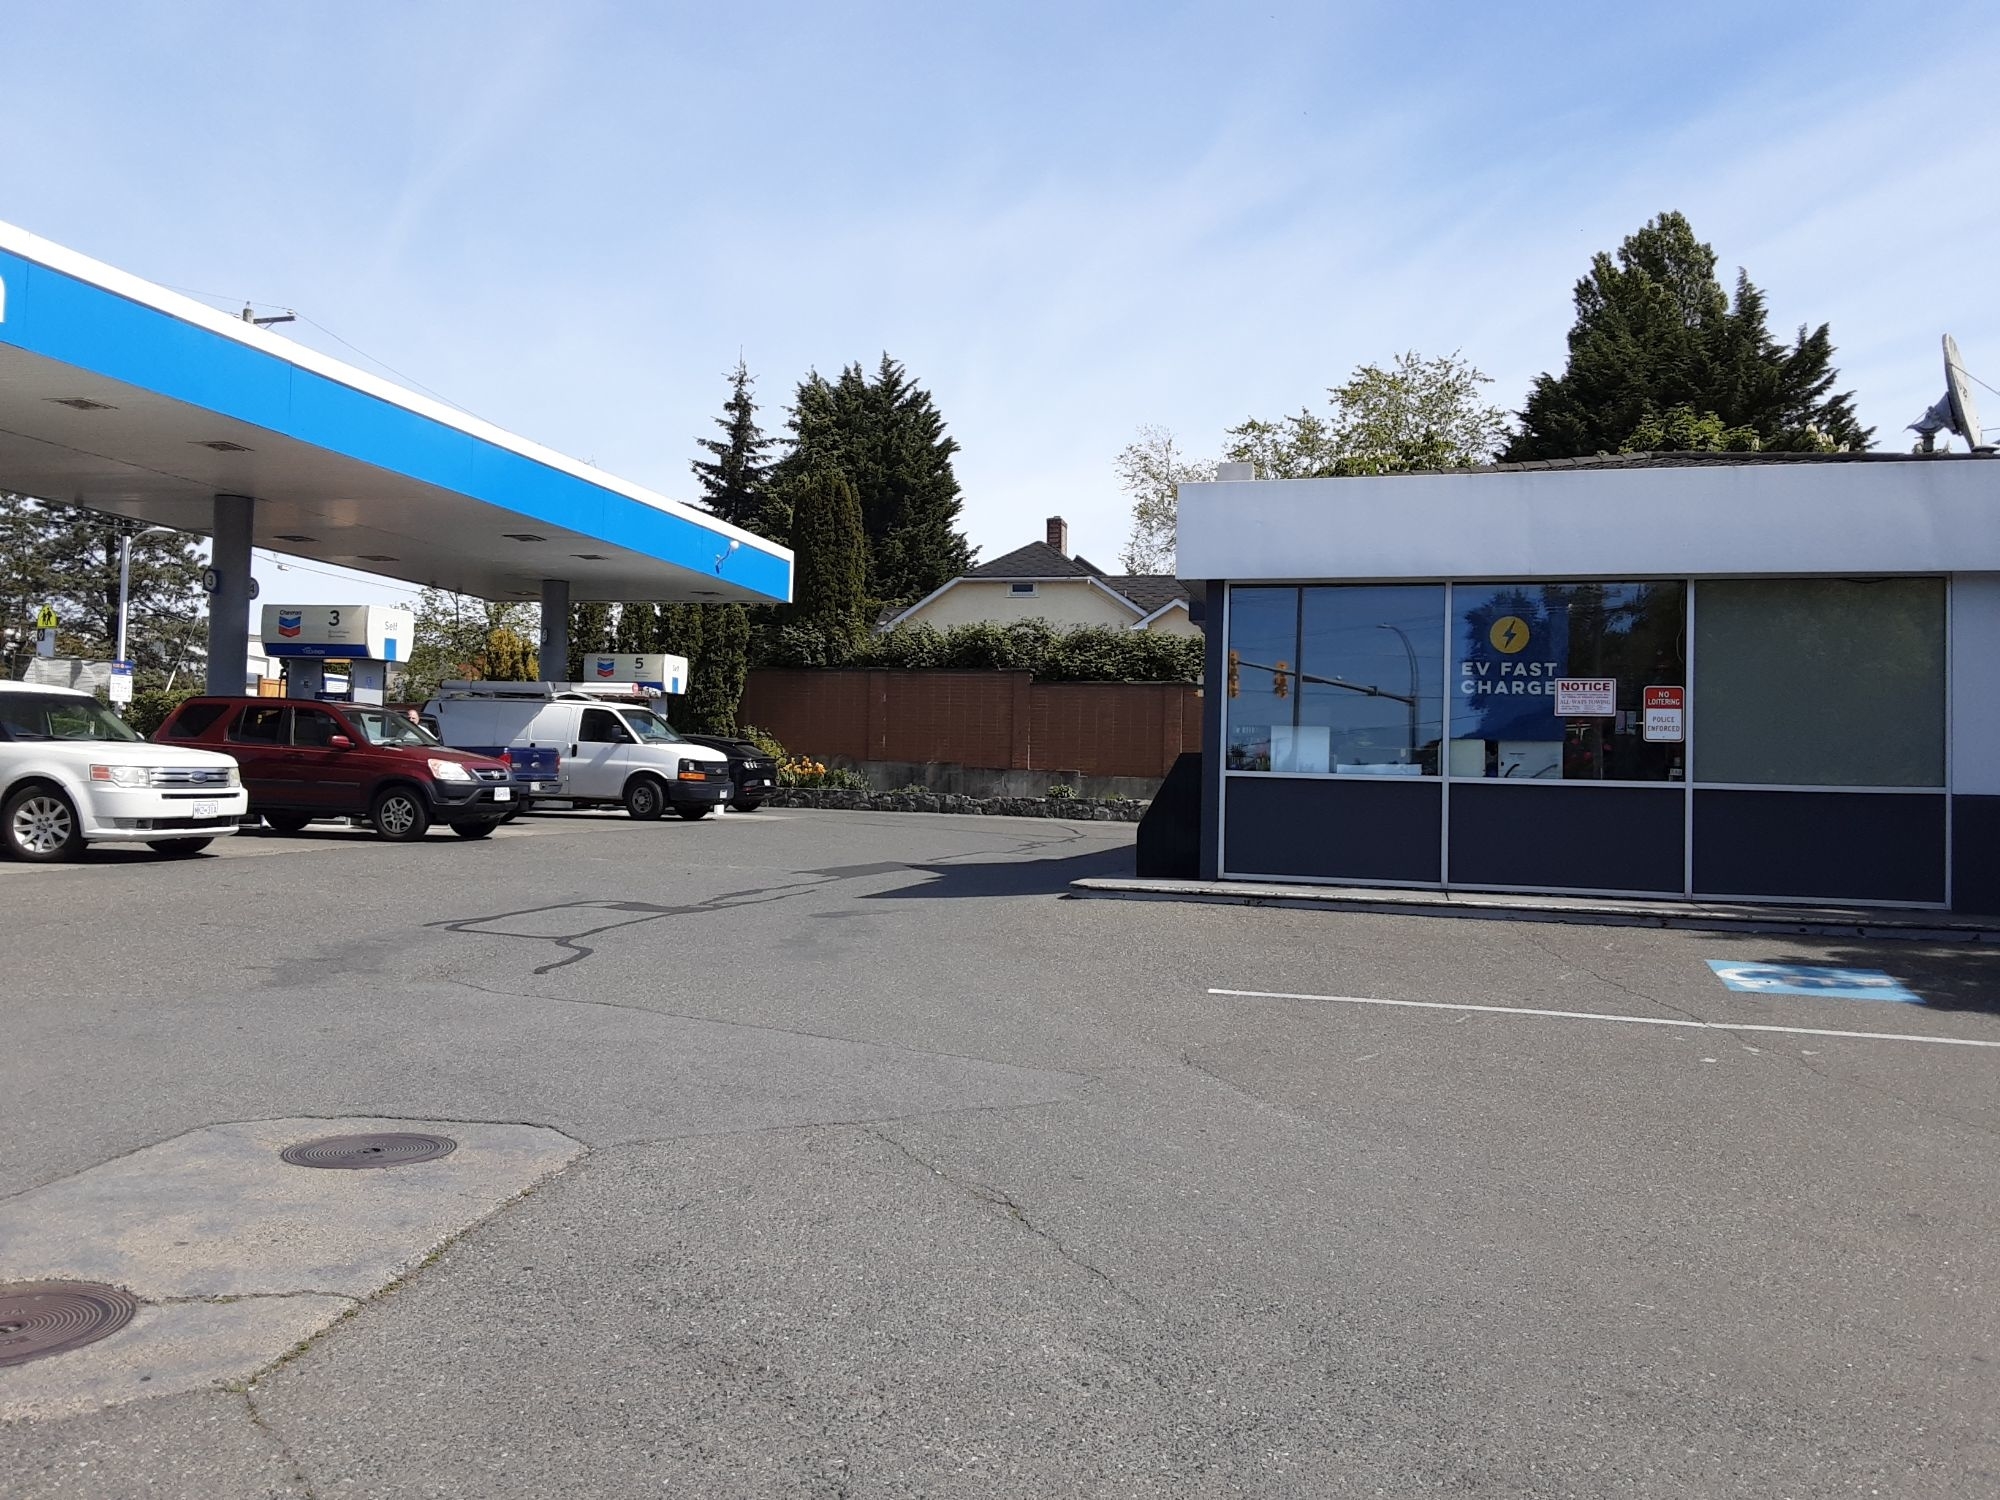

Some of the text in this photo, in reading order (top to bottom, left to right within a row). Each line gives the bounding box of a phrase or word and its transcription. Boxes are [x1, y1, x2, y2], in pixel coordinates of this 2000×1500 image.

[208, 575, 214, 586] 3
[328, 609, 340, 627] 3
[634, 657, 644, 669] 5
[1461, 662, 1558, 677] EV FAST
[1461, 680, 1556, 695] CHARGE
[1561, 682, 1611, 691] NOTICE
[1658, 690, 1670, 698] NO
[1647, 698, 1681, 706] LOITERING
